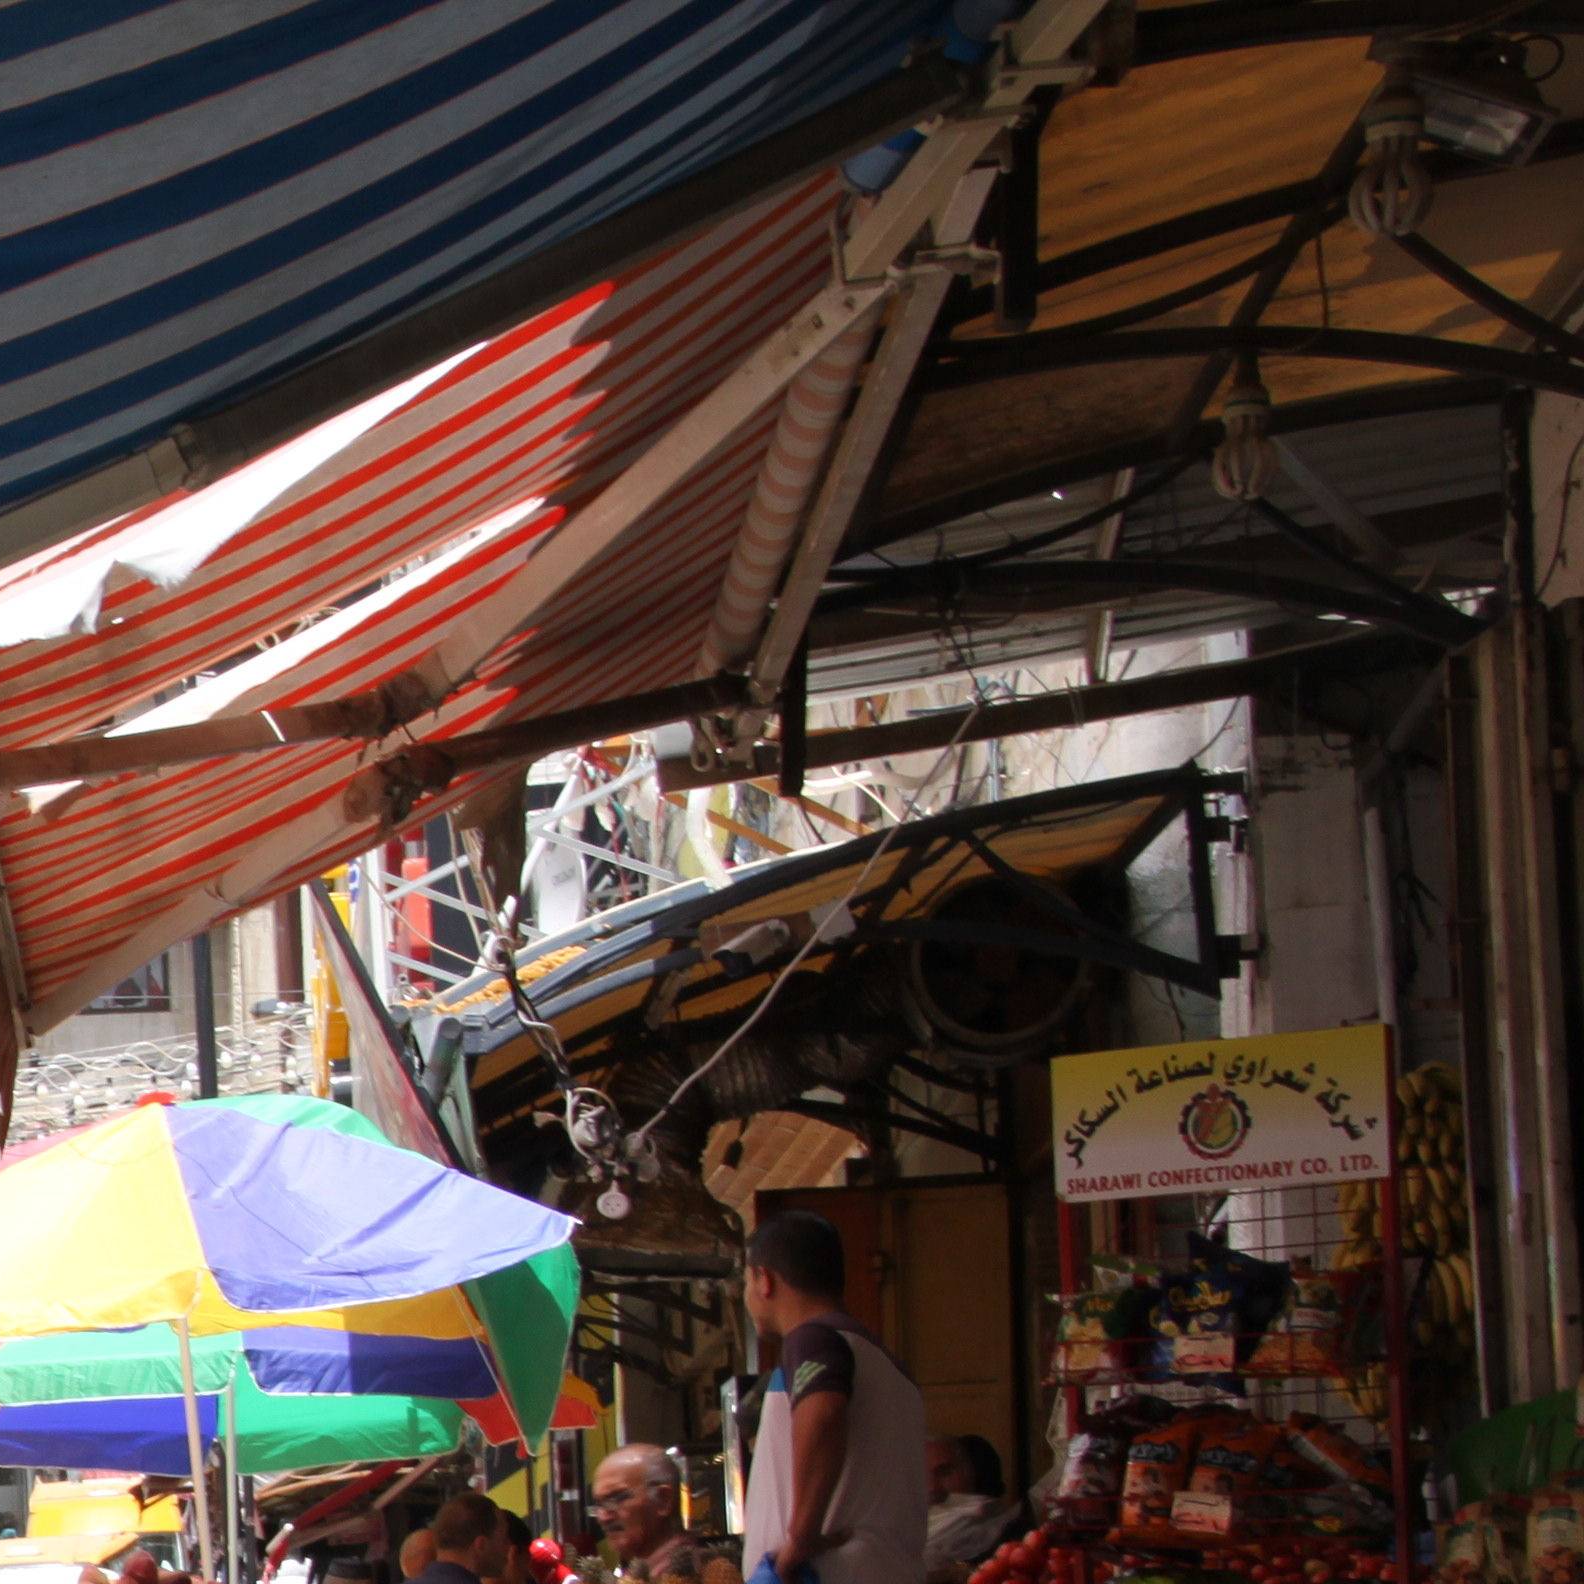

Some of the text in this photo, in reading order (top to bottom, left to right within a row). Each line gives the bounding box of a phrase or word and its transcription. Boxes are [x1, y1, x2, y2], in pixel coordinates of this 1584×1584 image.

[1064, 1051, 1379, 1169] شركة شعراوي لصناعة السكاكر
[1066, 1153, 1379, 1195] SHARAWI CONFECTIONARY CO. LTD.
